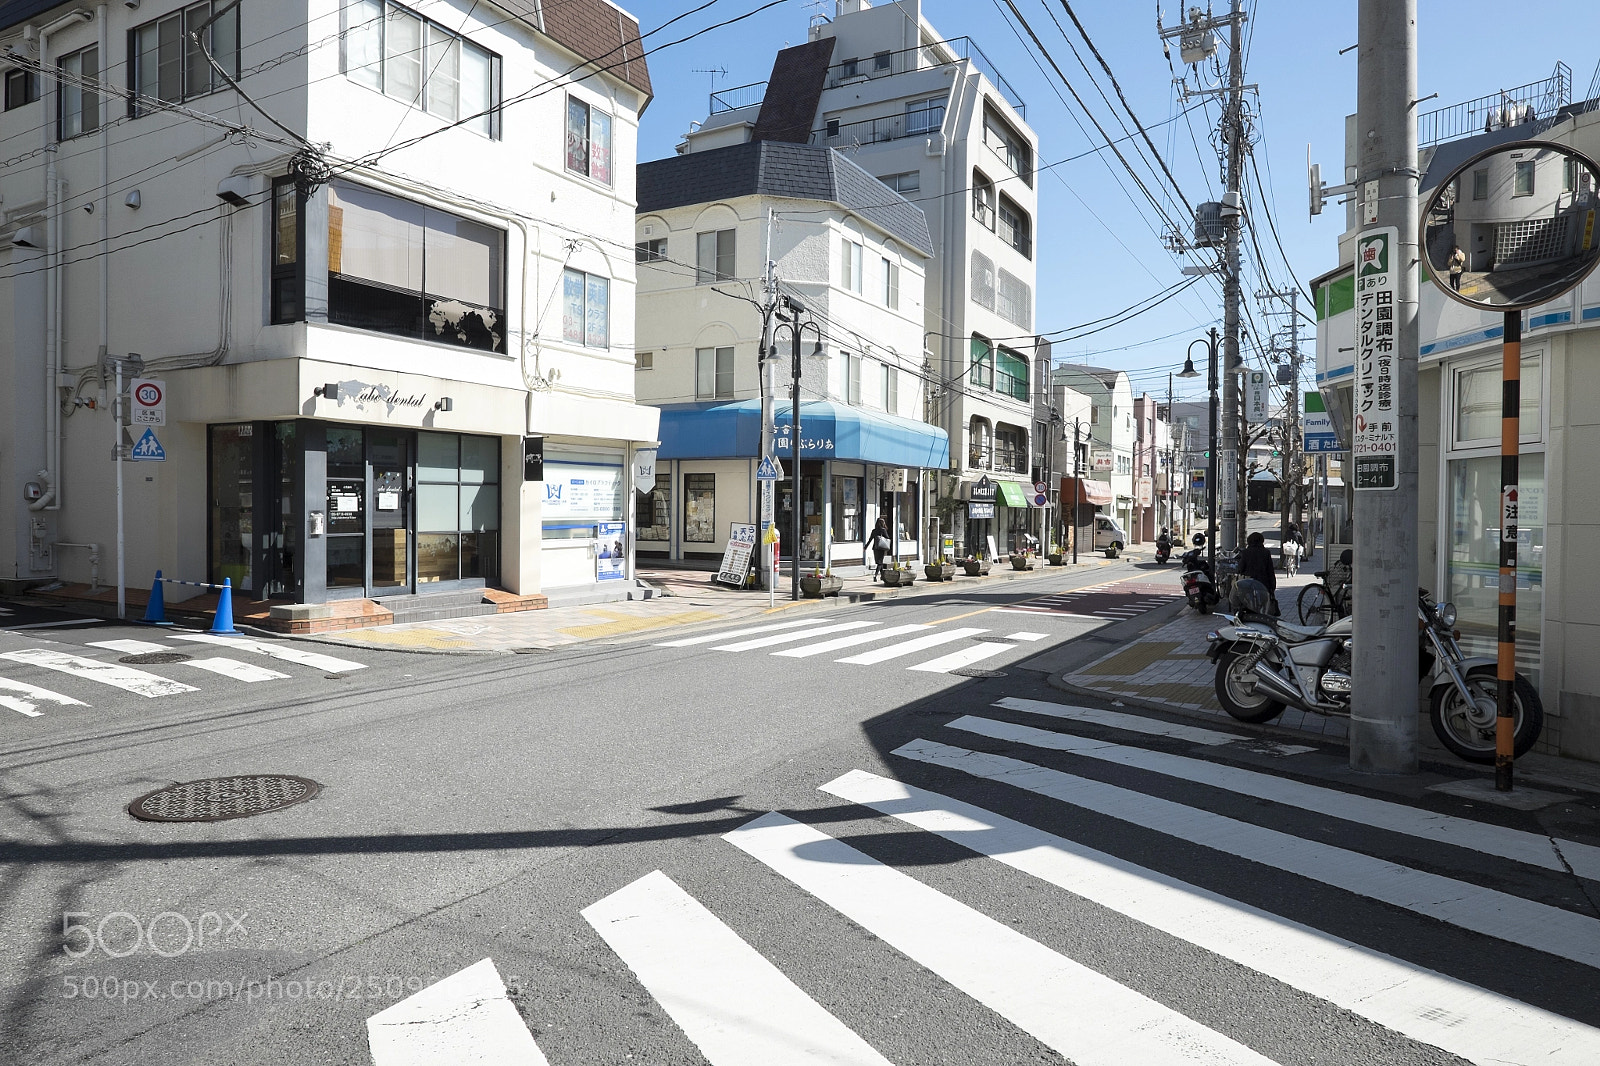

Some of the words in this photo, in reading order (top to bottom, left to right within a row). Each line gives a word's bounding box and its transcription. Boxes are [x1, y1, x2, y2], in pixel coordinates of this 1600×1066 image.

[1366, 275, 1387, 288] あり
[1376, 290, 1394, 353] 田園調布
[1361, 292, 1374, 413] デンタルクリニック
[141, 389, 157, 401] 30
[385, 389, 426, 408] dental
[136, 415, 161, 423] ここから
[1305, 418, 1331, 427] Family
[1368, 422, 1393, 433] 手前
[772, 437, 834, 453] 園ぶらりあ
[1308, 439, 1320, 450] 酒
